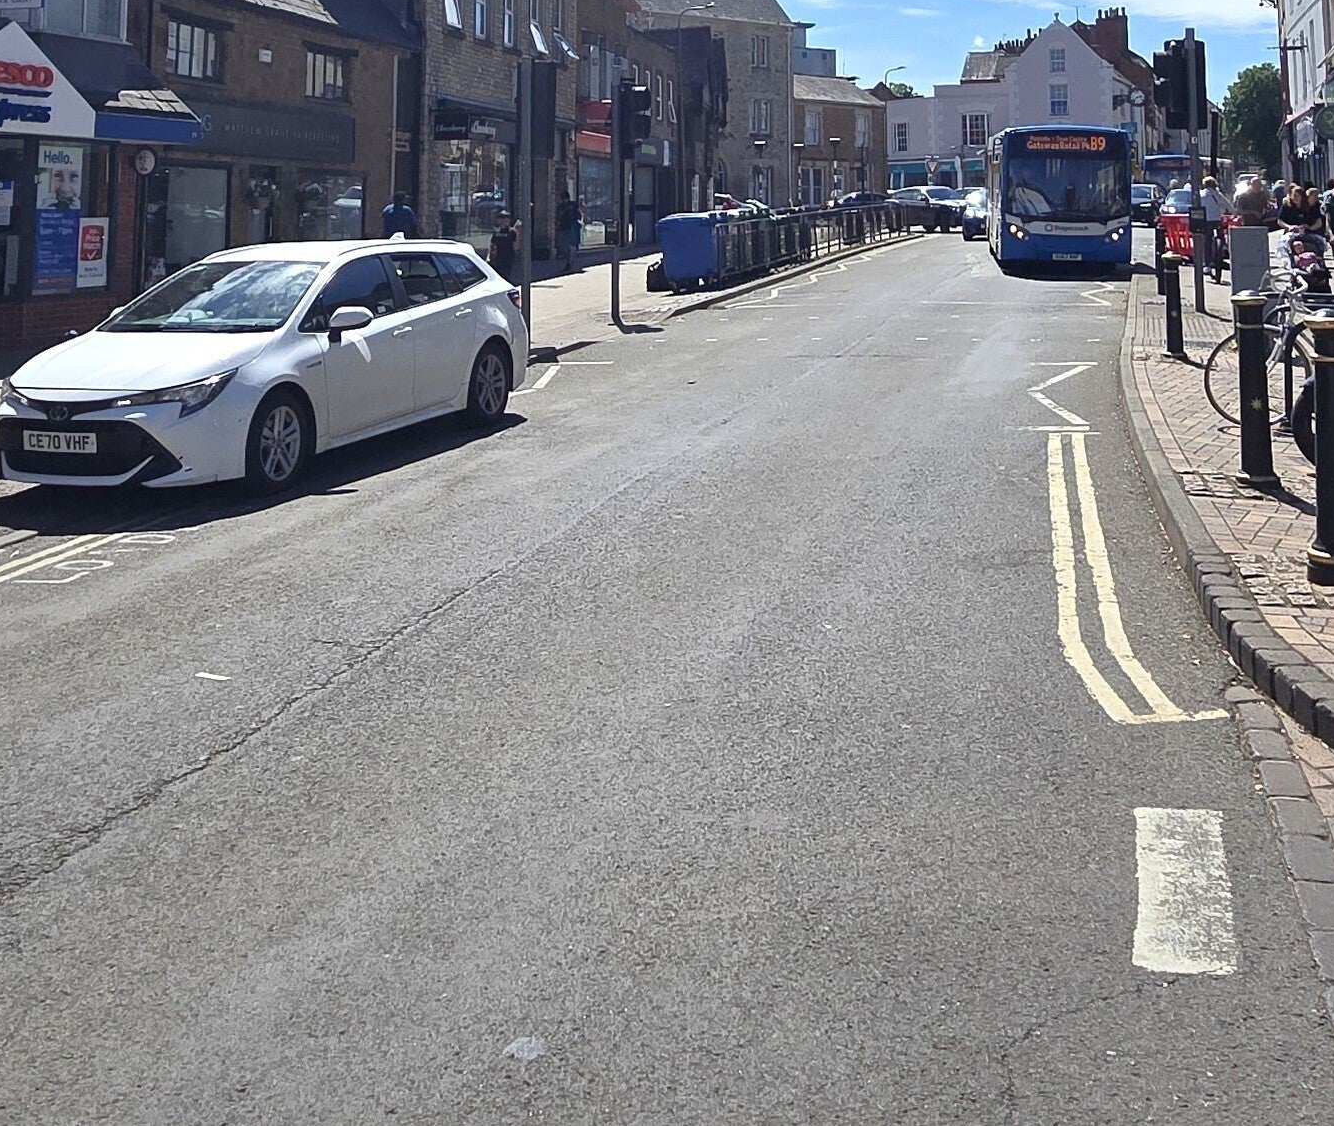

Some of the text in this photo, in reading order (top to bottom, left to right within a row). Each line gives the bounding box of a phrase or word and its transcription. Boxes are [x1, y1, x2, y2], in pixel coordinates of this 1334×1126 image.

[1090, 136, 1106, 151] B9
[43, 150, 73, 165] Hello.
[28, 433, 91, 451] CE70 VHF
